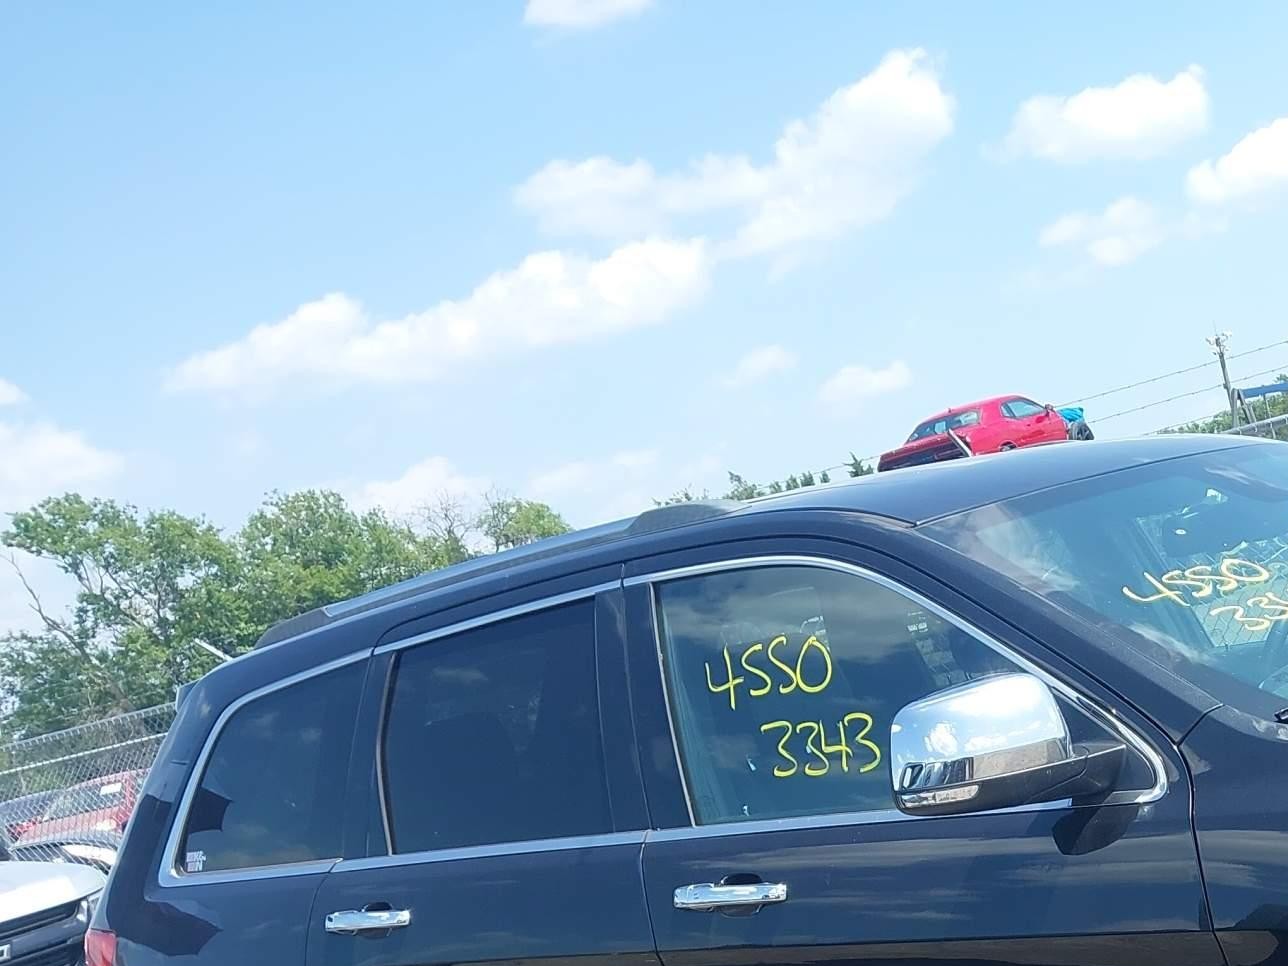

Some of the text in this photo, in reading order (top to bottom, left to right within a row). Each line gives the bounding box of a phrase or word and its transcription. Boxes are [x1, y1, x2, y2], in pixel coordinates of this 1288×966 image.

[1123, 559, 1269, 607] 4550
[705, 635, 832, 710] 4550
[761, 712, 881, 777] 3343
